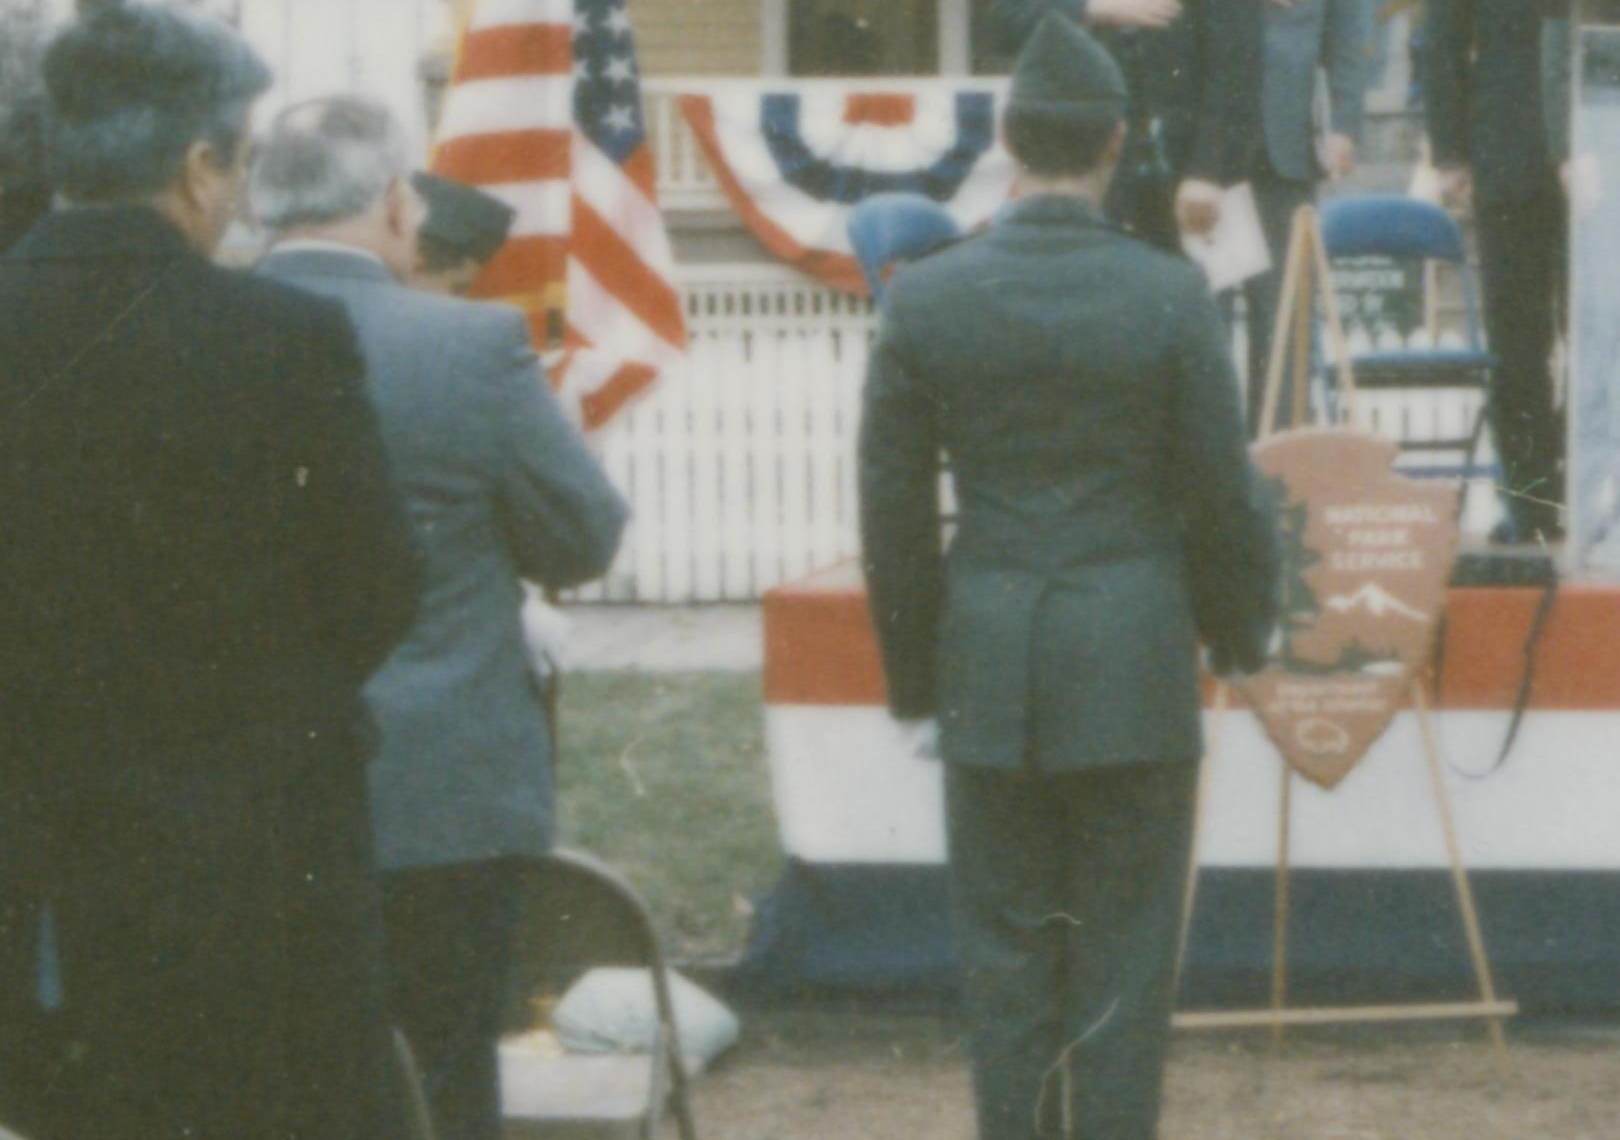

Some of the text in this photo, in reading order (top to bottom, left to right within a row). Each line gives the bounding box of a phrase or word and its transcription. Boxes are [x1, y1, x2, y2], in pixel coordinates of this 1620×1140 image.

[1325, 505, 1439, 525] NATIONAL
[1348, 528, 1408, 545] PARK
[1332, 551, 1424, 570] SERVICE
